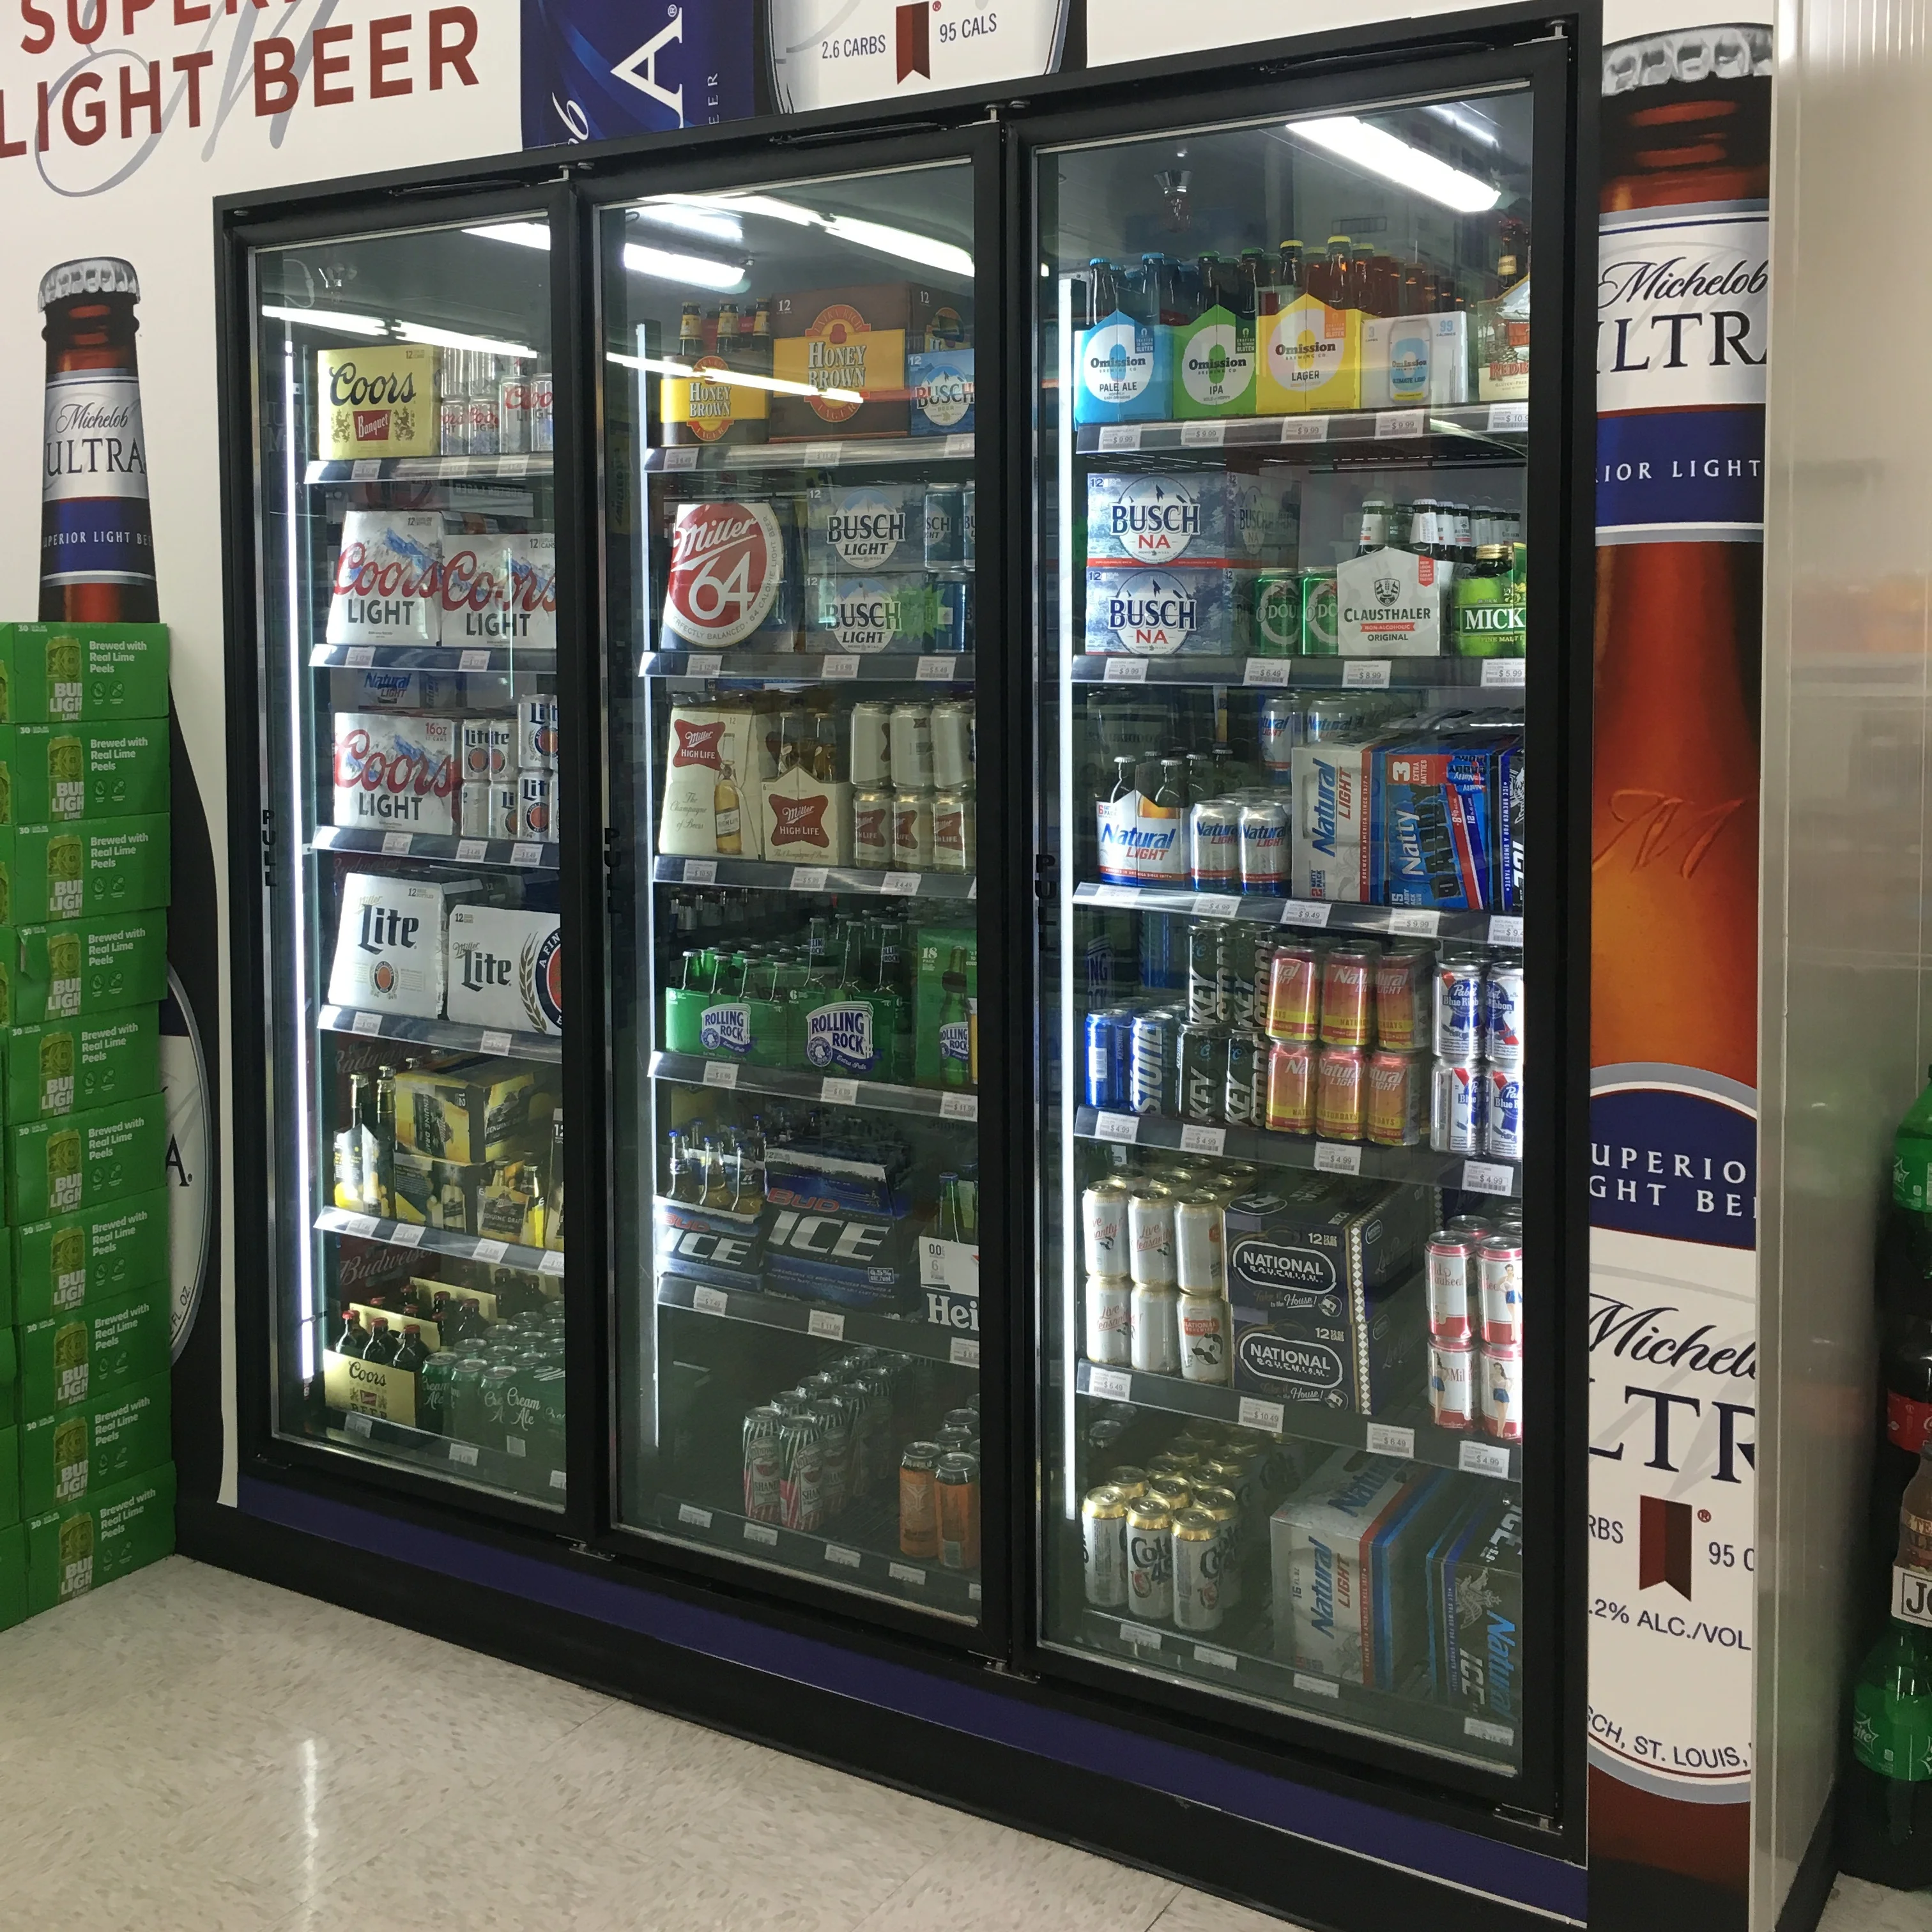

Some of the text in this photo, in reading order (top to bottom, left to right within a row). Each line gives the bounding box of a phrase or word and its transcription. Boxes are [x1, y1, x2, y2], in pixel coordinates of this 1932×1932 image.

[939, 13, 997, 43] 95 CALS
[822, 34, 886, 59] 2.6 CARBS
[0, 50, 213, 158] LIGHT
[254, 6, 479, 117] BEER
[1597, 257, 1768, 309] Michelob
[778, 300, 791, 311] 12
[920, 291, 930, 303] 12
[1439, 320, 1453, 332] 99
[1275, 342, 1336, 356] Omission
[1597, 310, 1767, 374] LTR
[808, 341, 867, 369] HONEY
[909, 356, 922, 365] 12
[1091, 356, 1147, 371] Omission
[1188, 358, 1246, 371] Omission
[329, 362, 416, 406] Coors
[808, 367, 866, 389] BROWN
[1291, 371, 1319, 381] LAGER
[689, 383, 732, 402] HONEY
[916, 383, 975, 409] BUSCH
[1100, 382, 1137, 392] PALE ALE
[1209, 385, 1223, 395] IPA
[56, 402, 128, 434] Michelob
[689, 403, 731, 417] BROWN
[357, 414, 389, 439] Banquet
[47, 437, 146, 477] ULTRA
[1596, 460, 1761, 483] IOR LIGHT
[1090, 479, 1103, 487] 12
[809, 489, 821, 498] 12
[827, 512, 906, 544] BUSCH
[1111, 504, 1200, 535] BUSCH
[43, 531, 151, 548] UPERIOR LIGHT BEE
[530, 539, 539, 549] 12
[674, 517, 758, 562] Miller
[844, 542, 889, 556] LIGHT
[1138, 534, 1171, 549] NA
[334, 542, 442, 599] Coors
[673, 615, 705, 639] ERFECTLY
[707, 624, 746, 640] BALANCED
[749, 611, 759, 622] 64
[762, 516, 775, 538] BEER
[1089, 572, 1101, 581] 12
[688, 551, 755, 620] 64
[806, 577, 818, 586] 12
[348, 599, 415, 626] LIGHT
[825, 601, 901, 631] BUSCH
[1108, 599, 1196, 631] BUSCH
[1344, 608, 1431, 622] CLAUSTHALER
[1464, 608, 1526, 630] MICK
[466, 613, 532, 637] LIGHT
[90, 641, 147, 651] Brewed with
[842, 631, 885, 644] LIGHT
[1135, 629, 1169, 644] NA
[1367, 633, 1408, 641] ORIGINAL
[90, 652, 135, 662] Real Lime
[90, 663, 114, 673] Peels
[380, 689, 406, 698] LIGHT
[50, 698, 82, 713] LIGH
[91, 737, 148, 749] Brewed with
[686, 730, 714, 747] Miller
[91, 749, 135, 760] Real Lime
[681, 748, 715, 759] HIGH LIFE
[91, 761, 116, 771] Peels
[334, 729, 455, 798] Coors
[1393, 761, 1411, 781] 3
[1338, 765, 1353, 820] LIGHT
[358, 792, 423, 821] LIGHT
[782, 804, 815, 824] Miller
[1312, 758, 1336, 858] Natural
[779, 825, 820, 836] HIGH LIFE
[1101, 822, 1177, 850] Natural
[1256, 839, 1284, 848] LIGHT
[1398, 809, 1425, 876] Natty
[1126, 846, 1169, 861] LIGHT
[408, 888, 417, 897] 12
[455, 914, 464, 923] 12
[89, 928, 146, 944] Brewed with
[358, 904, 419, 955] Lite
[89, 941, 133, 955] Real Lime
[922, 947, 937, 958] 18
[89, 956, 114, 967] Peels
[461, 949, 512, 992] Lite
[1443, 995, 1460, 1006] Blue
[705, 1009, 744, 1026] ROLLING
[811, 1012, 864, 1034] ROLLING
[720, 1026, 744, 1041] ROCK
[832, 1032, 864, 1048] ROCK
[949, 1039, 968, 1051] ROCK
[1330, 1076, 1361, 1087] LIGHT
[1495, 1098, 1513, 1108] Blue
[88, 1117, 144, 1138] Brewed with
[89, 1132, 132, 1149] Real Lime
[89, 1147, 113, 1160] Peels
[1591, 1143, 1746, 1183] UPERIO
[767, 1187, 840, 1213] BUD
[1590, 1176, 1667, 1206] GHT
[768, 1209, 892, 1261] ICE
[1308, 1232, 1322, 1245] 12
[658, 1227, 751, 1265] ICE
[1243, 1251, 1324, 1276] NATIONAL
[1100, 1305, 1120, 1320] Live
[1315, 1327, 1329, 1340] 12
[1589, 1292, 1756, 1379] Michel
[1250, 1343, 1331, 1370] NATIONAL
[349, 1360, 387, 1386] Coors
[506, 1387, 541, 1410] Cream
[512, 1410, 535, 1431] Ale
[1589, 1377, 1755, 1484] LTR
[1708, 1541, 1735, 1567] 95
[1308, 1535, 1335, 1639] Natural
[1337, 1553, 1351, 1609] LIGHT
[1588, 1598, 1752, 1651] .2% ALC./VOL
[1487, 1609, 1518, 1721] Natural
[1633, 1735, 1748, 1768] ST. LOUIS,
